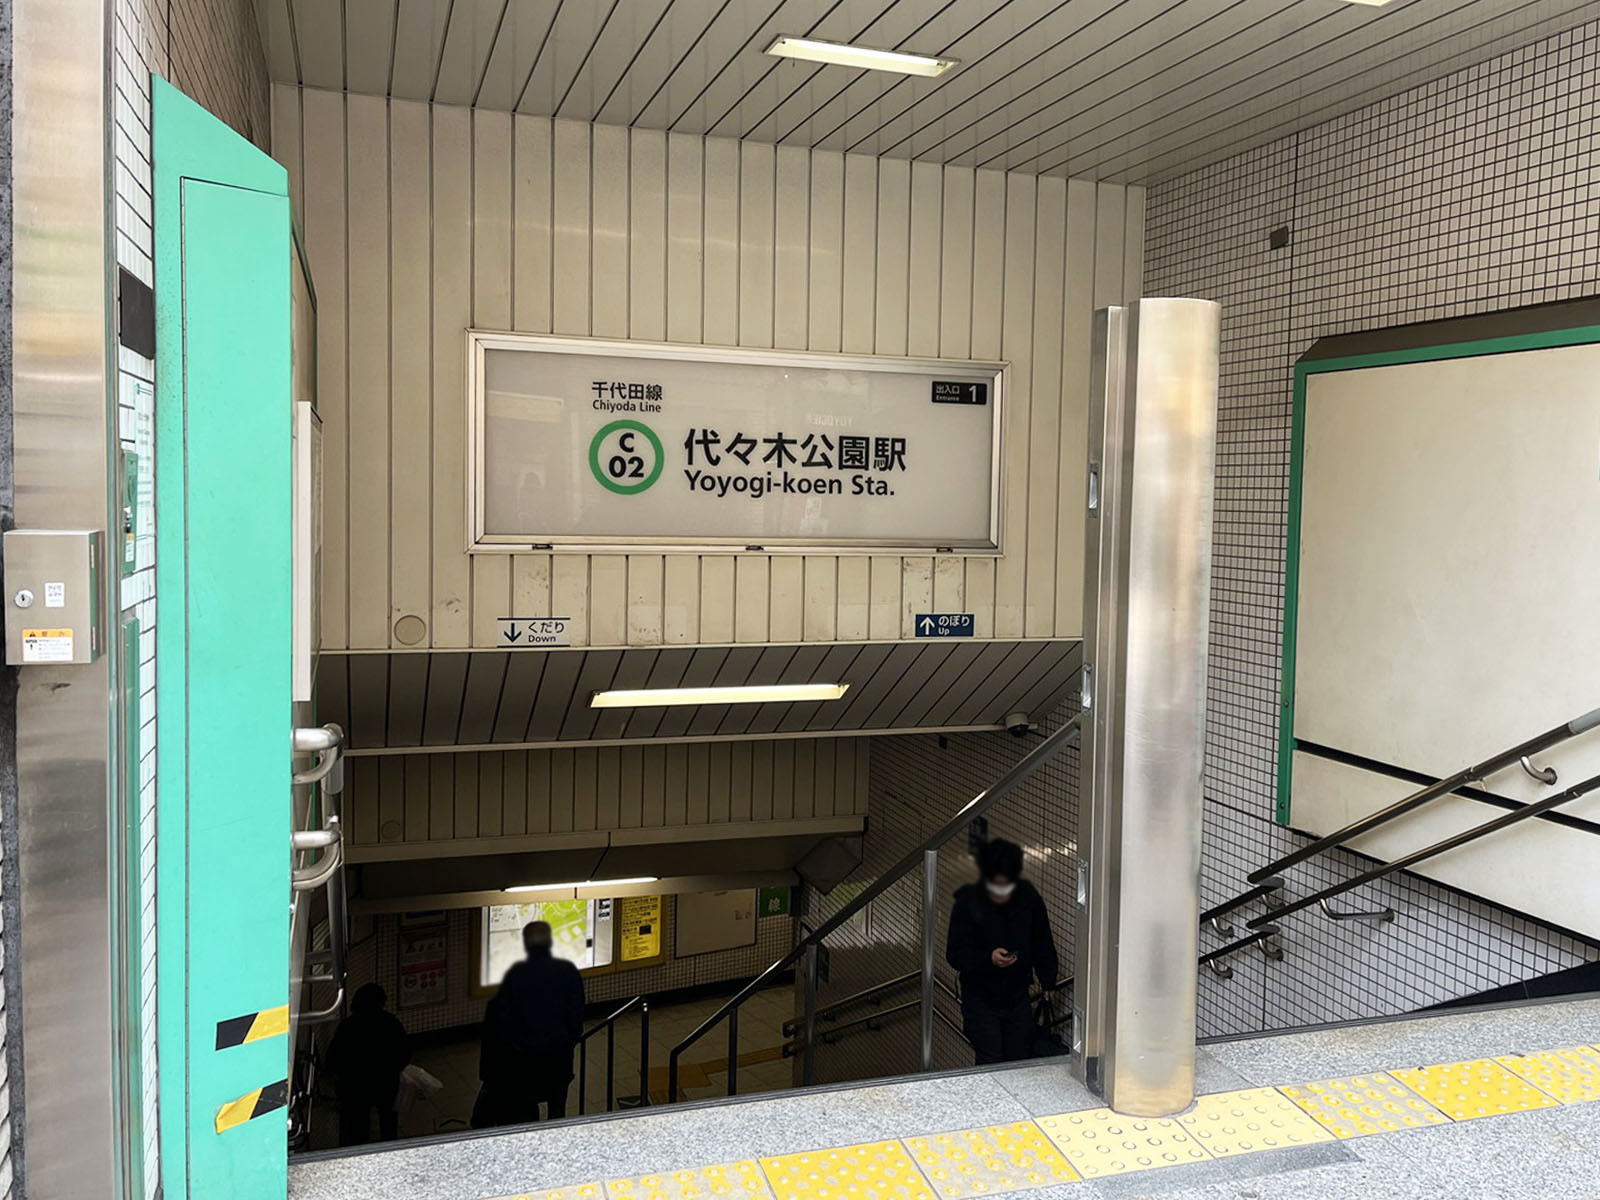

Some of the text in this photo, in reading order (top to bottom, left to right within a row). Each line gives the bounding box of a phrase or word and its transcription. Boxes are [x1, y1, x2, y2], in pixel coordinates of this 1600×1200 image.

[592, 381, 663, 401] 千代田線
[935, 383, 977, 402] 出入口 1
[592, 399, 662, 413] Chiyoda Line
[619, 432, 635, 453] C
[683, 428, 907, 472] 代々木公園駅
[608, 455, 645, 478] 02
[684, 469, 895, 499] Yoyogi-koen Sta.
[528, 621, 565, 634] くだり
[938, 615, 970, 627] のぼり
[528, 634, 557, 643] Down
[938, 627, 950, 636] Up
